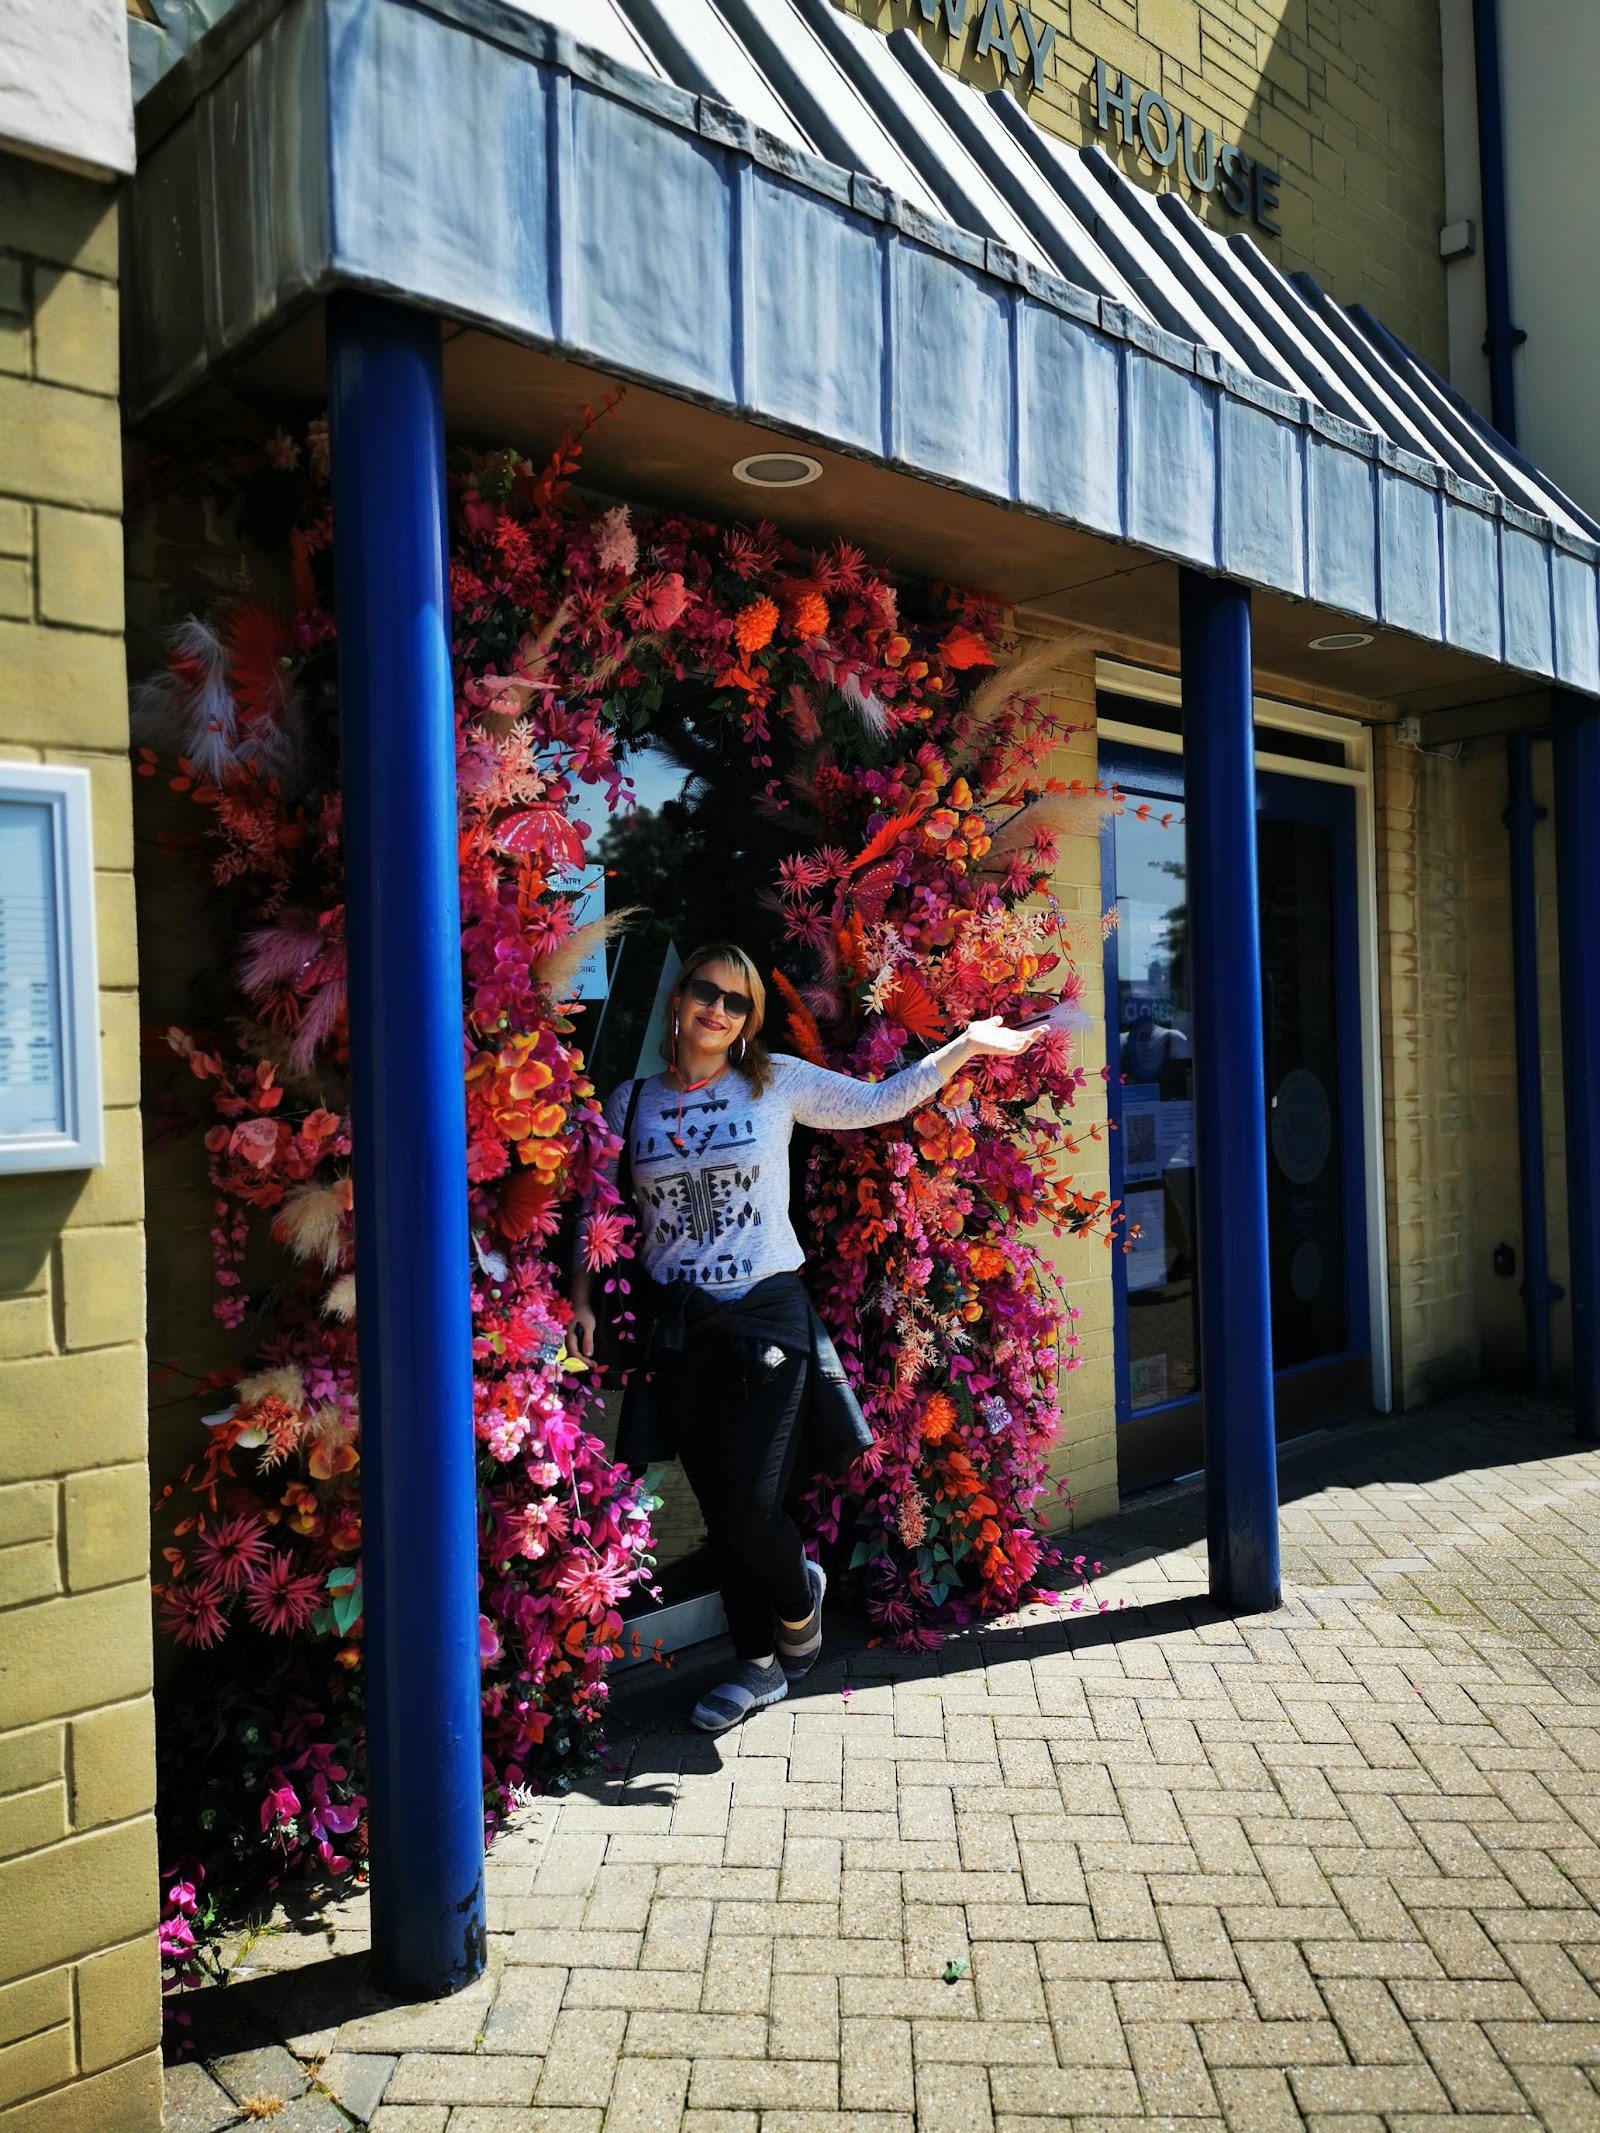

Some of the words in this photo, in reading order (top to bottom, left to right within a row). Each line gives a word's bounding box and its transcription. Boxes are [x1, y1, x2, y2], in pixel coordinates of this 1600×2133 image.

[1096, 57, 1282, 237] HOUSE
[560, 876, 582, 886] ENTRY
[1124, 1002, 1173, 1022] CLOSED
